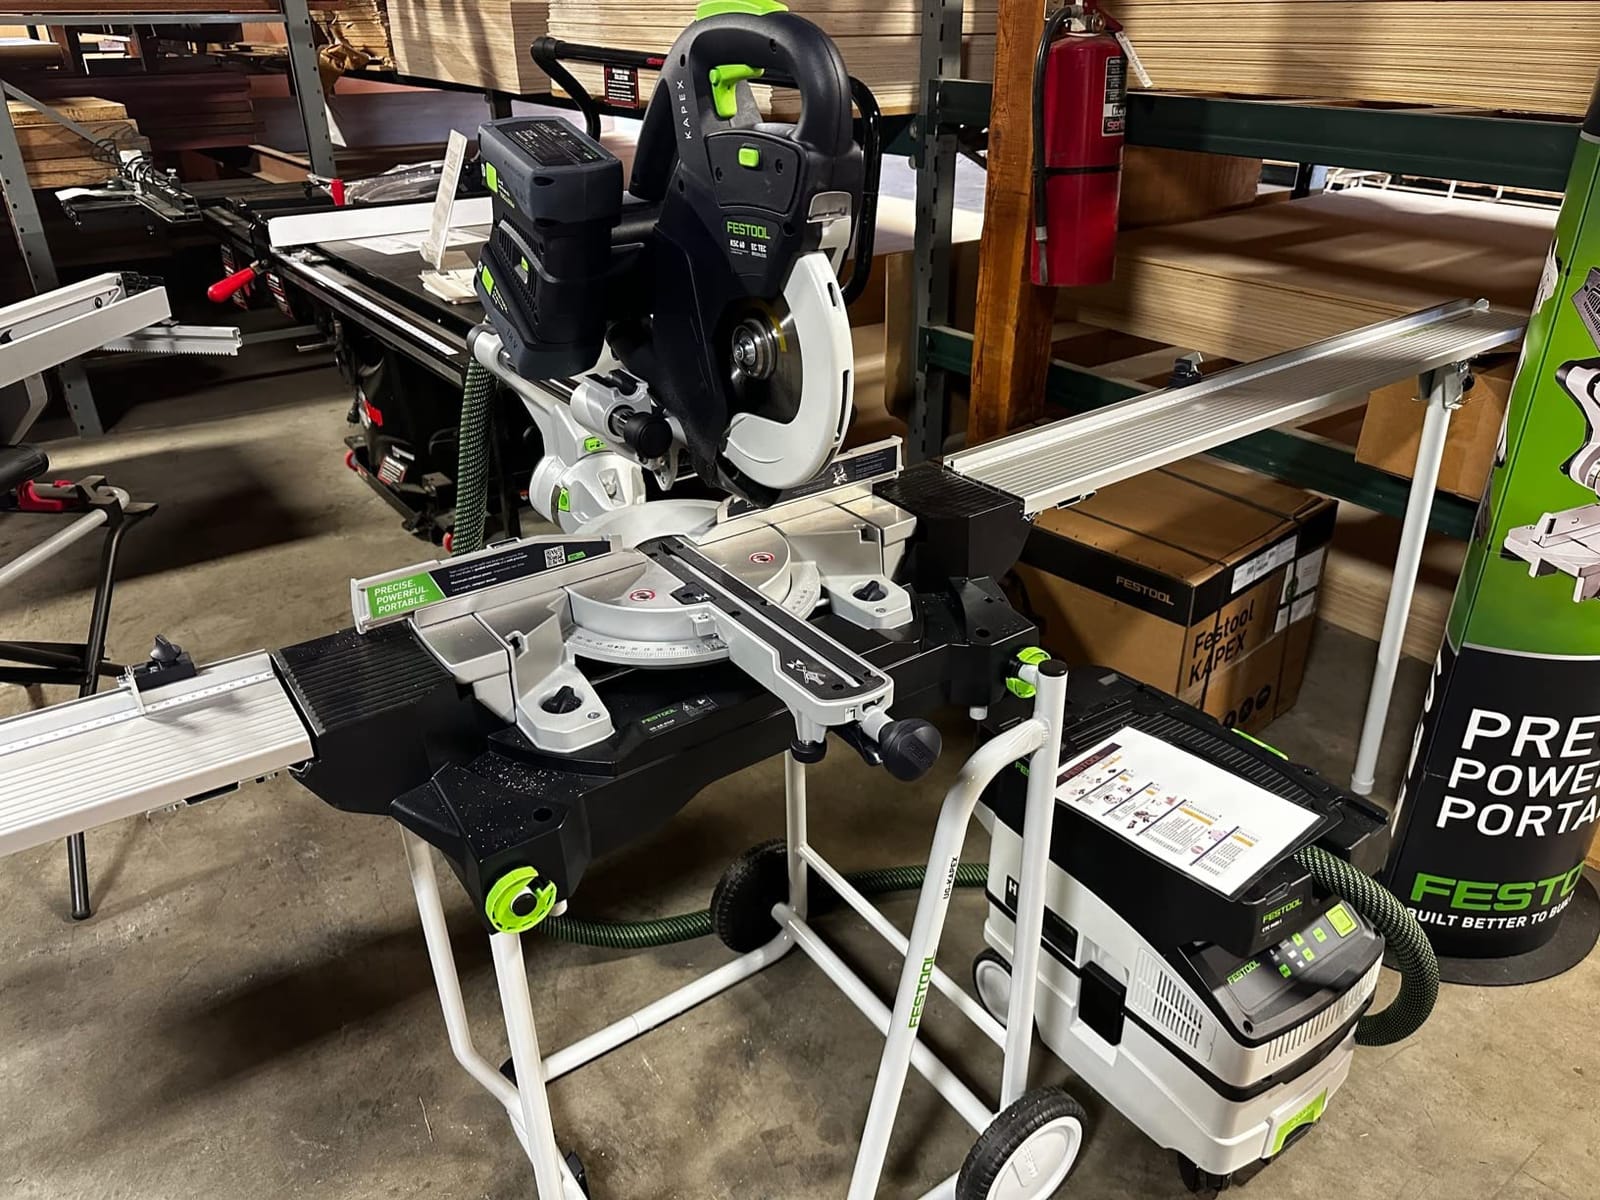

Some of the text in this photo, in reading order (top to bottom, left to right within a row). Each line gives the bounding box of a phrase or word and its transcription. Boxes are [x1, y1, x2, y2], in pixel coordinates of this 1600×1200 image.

[677, 80, 692, 139] KAPEX
[727, 221, 771, 239] FESTOOL
[374, 579, 416, 597] PRECISE.
[376, 585, 429, 605] POWERFUL.
[1115, 575, 1175, 606] FESTOOL
[378, 594, 428, 614] PORTABLE.
[1192, 599, 1254, 659] Festool
[1188, 629, 1247, 687] KAPEX
[1448, 757, 1600, 798] POWE
[1436, 795, 1600, 837] PORTA
[943, 855, 959, 900] UG-KAPEX
[1262, 898, 1303, 924] FESTOOL
[1461, 915, 1528, 930] BETTER
[1531, 909, 1547, 925] TO
[1226, 960, 1261, 986] FESTOOL
[908, 950, 937, 1029] FESTOOL
